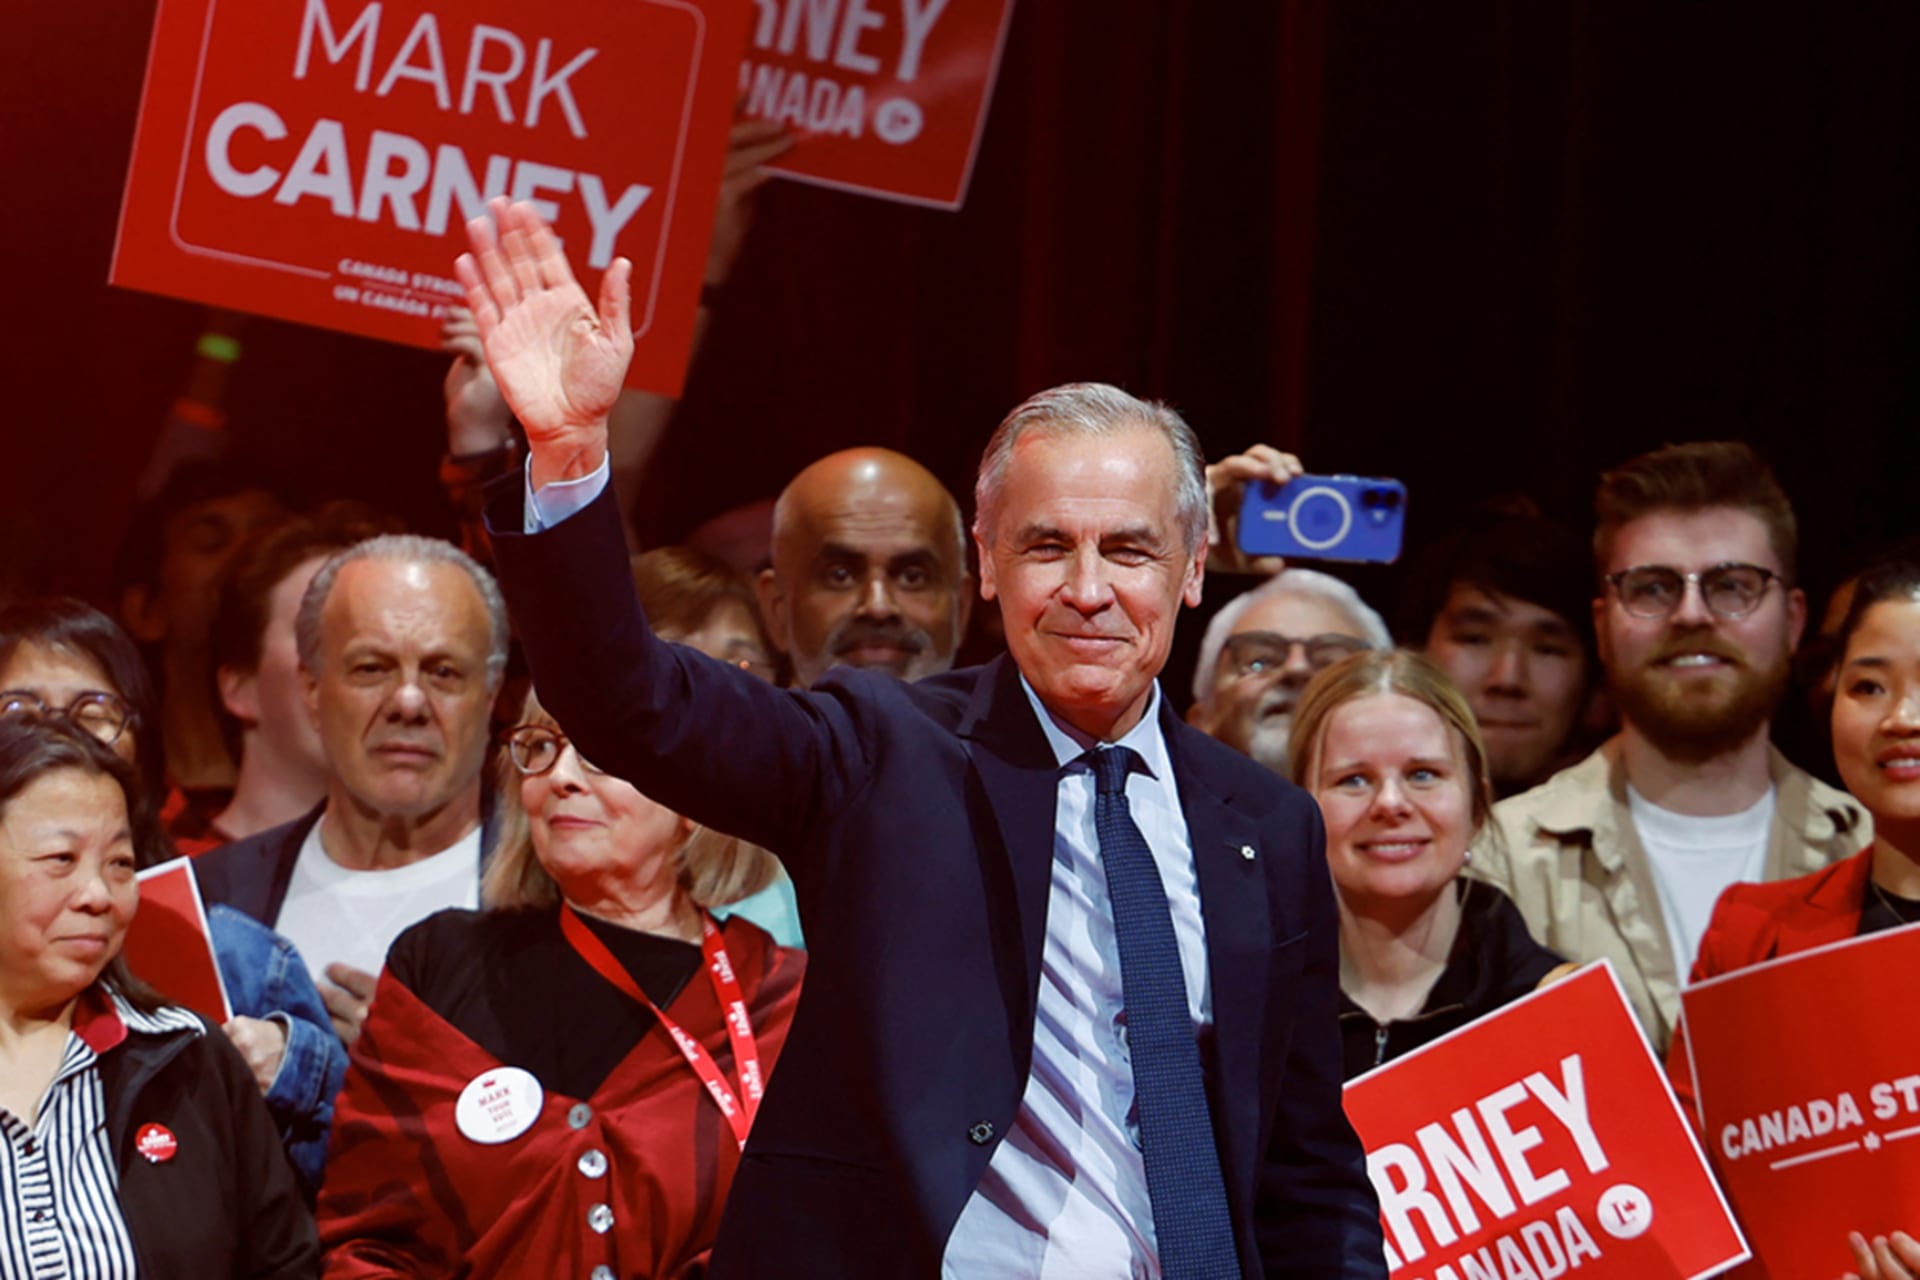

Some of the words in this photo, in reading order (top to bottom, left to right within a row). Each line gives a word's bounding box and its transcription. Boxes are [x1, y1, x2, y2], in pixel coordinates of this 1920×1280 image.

[293, 0, 598, 140] MARK
[205, 101, 653, 270] CARNEY
[333, 285, 359, 302] UN
[361, 290, 429, 316] CANADA
[338, 258, 408, 285] CANADA
[1366, 1053, 1610, 1272] RNEY
[1722, 1091, 1864, 1160] CANADA
[1410, 1205, 1602, 1280] NADA
